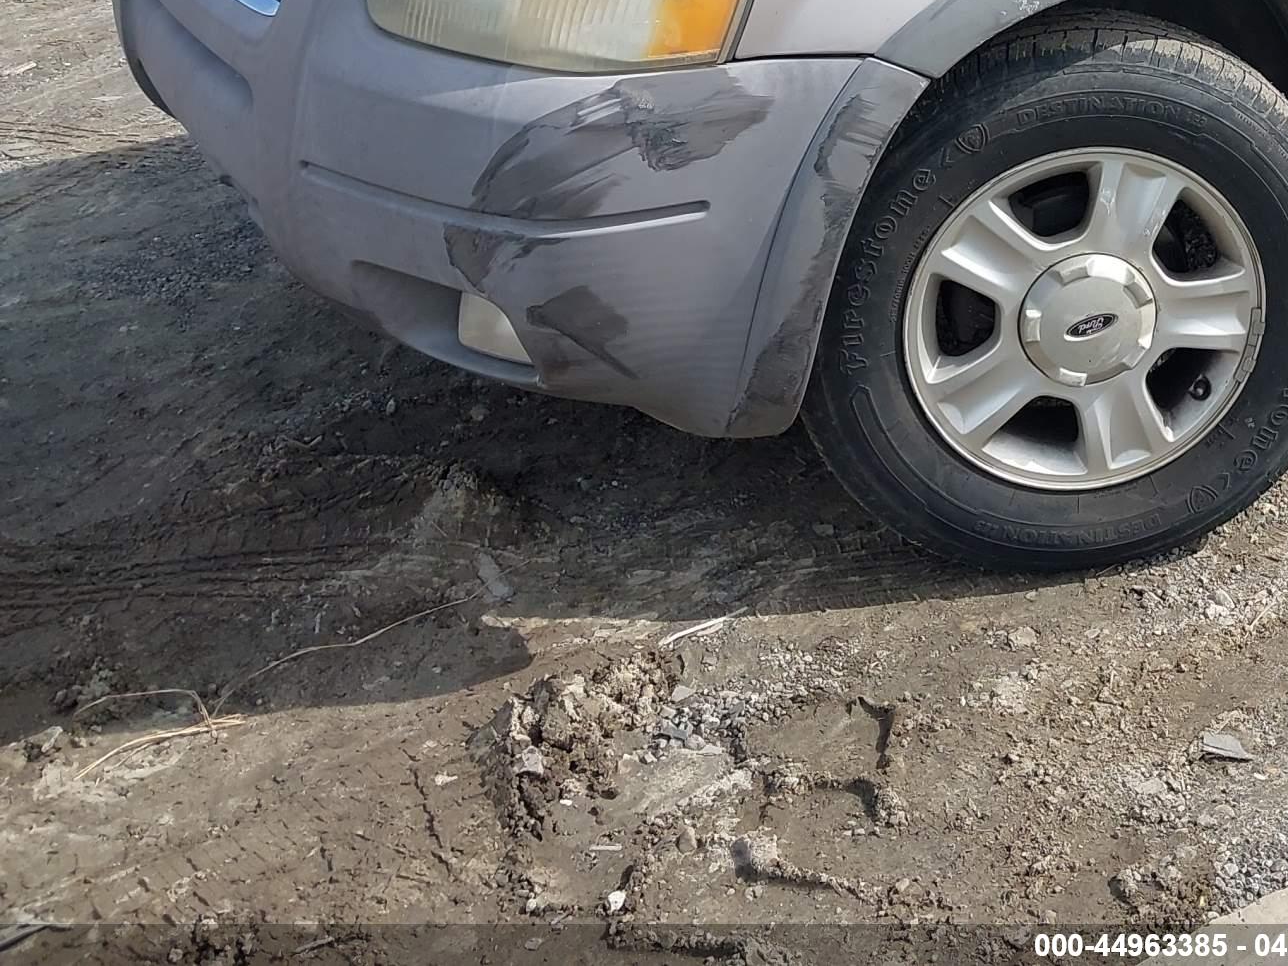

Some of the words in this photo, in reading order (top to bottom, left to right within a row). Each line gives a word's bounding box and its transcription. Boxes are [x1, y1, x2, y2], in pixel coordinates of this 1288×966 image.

[1016, 95, 1181, 126] DESTINATION
[837, 167, 938, 376] Firestone
[1078, 317, 1105, 334] Ford
